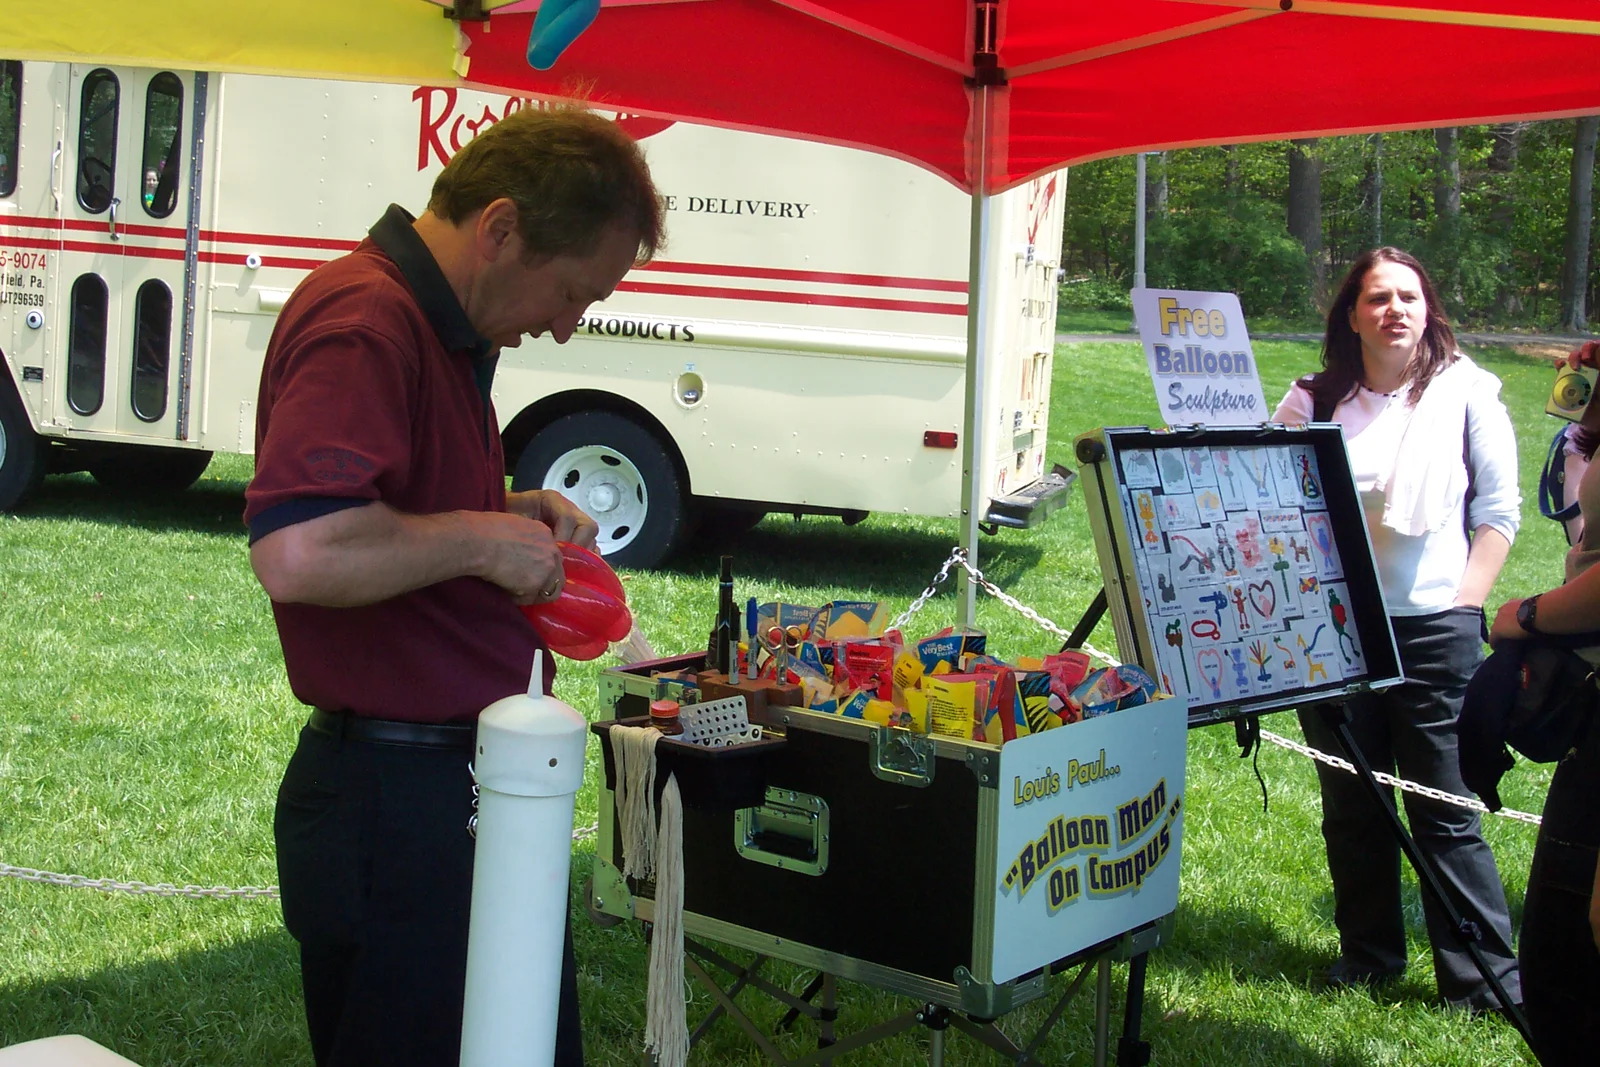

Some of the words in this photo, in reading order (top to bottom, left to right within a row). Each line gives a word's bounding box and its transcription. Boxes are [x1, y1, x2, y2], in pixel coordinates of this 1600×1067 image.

[687, 196, 811, 219] DELIVERY
[30, 274, 45, 289] Pa.
[573, 317, 695, 342] PRODUCTS
[1158, 296, 1226, 337] Free
[1153, 343, 1252, 376] Balloon
[1168, 381, 1257, 417] Sculpture
[1013, 766, 1061, 806] Louis
[1067, 748, 1121, 790] Paul...
[1002, 814, 1112, 896] "Balloon
[1115, 777, 1168, 845] Man
[1048, 864, 1081, 912] On
